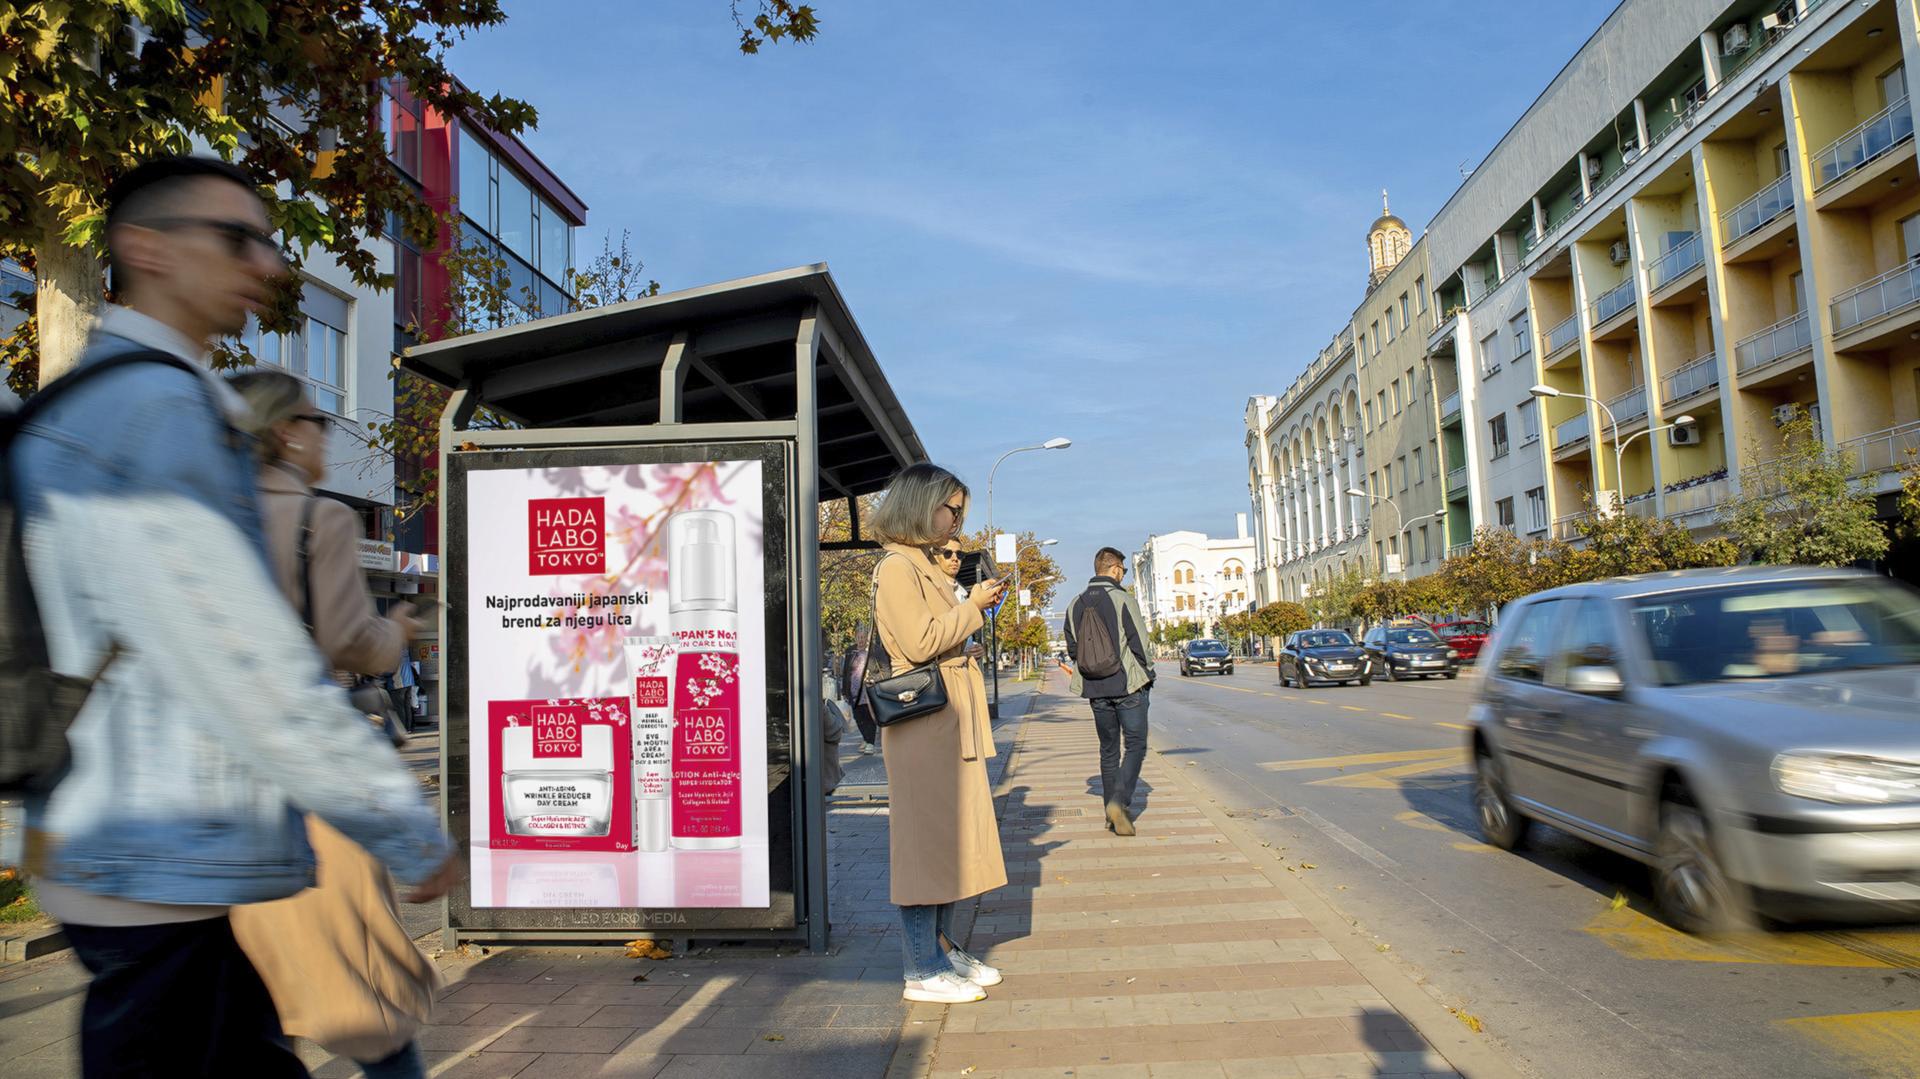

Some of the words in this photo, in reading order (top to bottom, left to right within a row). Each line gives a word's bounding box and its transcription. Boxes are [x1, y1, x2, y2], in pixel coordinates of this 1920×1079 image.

[537, 508, 597, 527] HADA
[537, 528, 597, 547] LABO
[486, 593, 586, 611] Najprodavaniji
[589, 591, 649, 609] japanski
[502, 614, 542, 629] brend
[546, 617, 561, 628] za
[565, 614, 604, 630] njegu
[607, 612, 633, 626] lica
[692, 640, 716, 648] CARE
[718, 640, 737, 649] LINE
[640, 680, 665, 689] HADA
[640, 688, 665, 698] LABO
[537, 712, 577, 726] HADA
[685, 715, 725, 729] HADA
[538, 726, 577, 740] LABO
[685, 729, 725, 742] LABO
[642, 911, 687, 924] MEDIA
